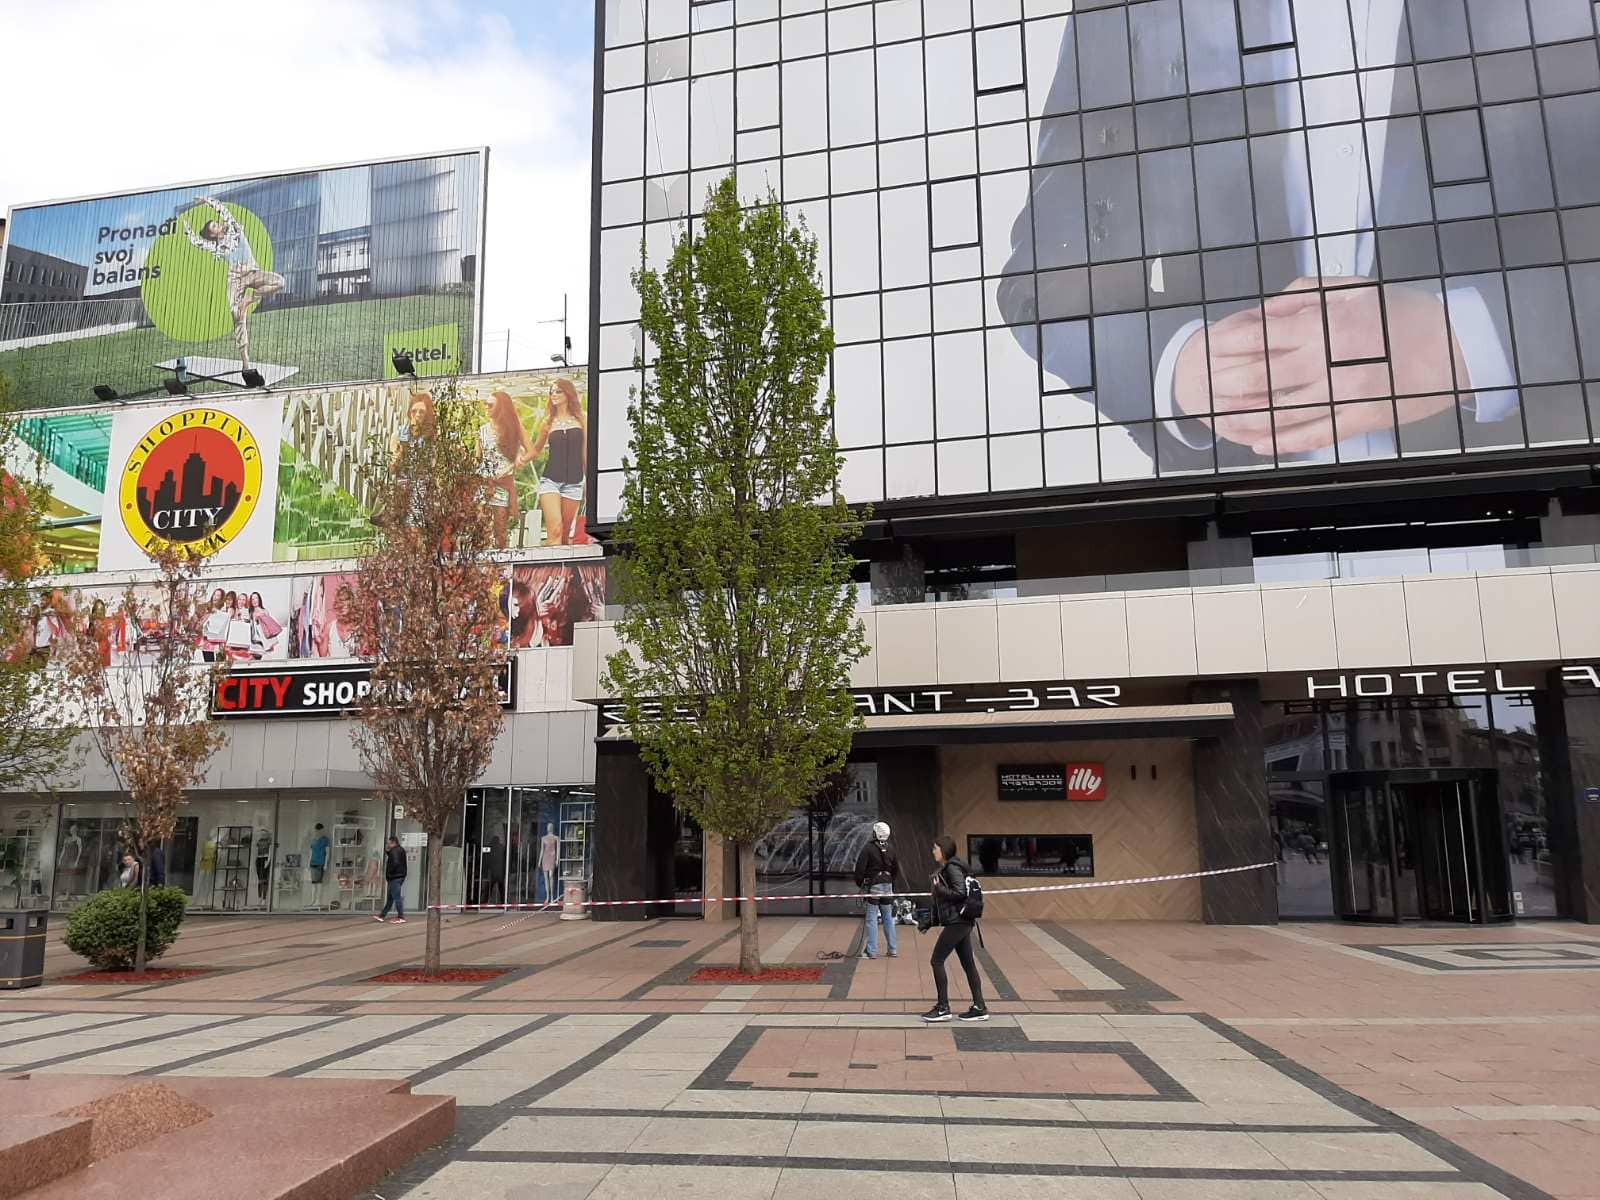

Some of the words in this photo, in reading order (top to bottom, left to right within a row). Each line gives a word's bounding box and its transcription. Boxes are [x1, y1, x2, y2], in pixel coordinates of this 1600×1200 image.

[98, 217, 177, 244] Pronađi
[95, 244, 134, 265] svoj
[92, 265, 161, 286] balans
[127, 411, 257, 473] SHOPPING
[153, 506, 223, 530] CITY
[218, 676, 292, 710] CITY
[1307, 669, 1536, 698] HOTEL
[1008, 685, 1121, 710] BAR
[1068, 768, 1102, 795] illy
